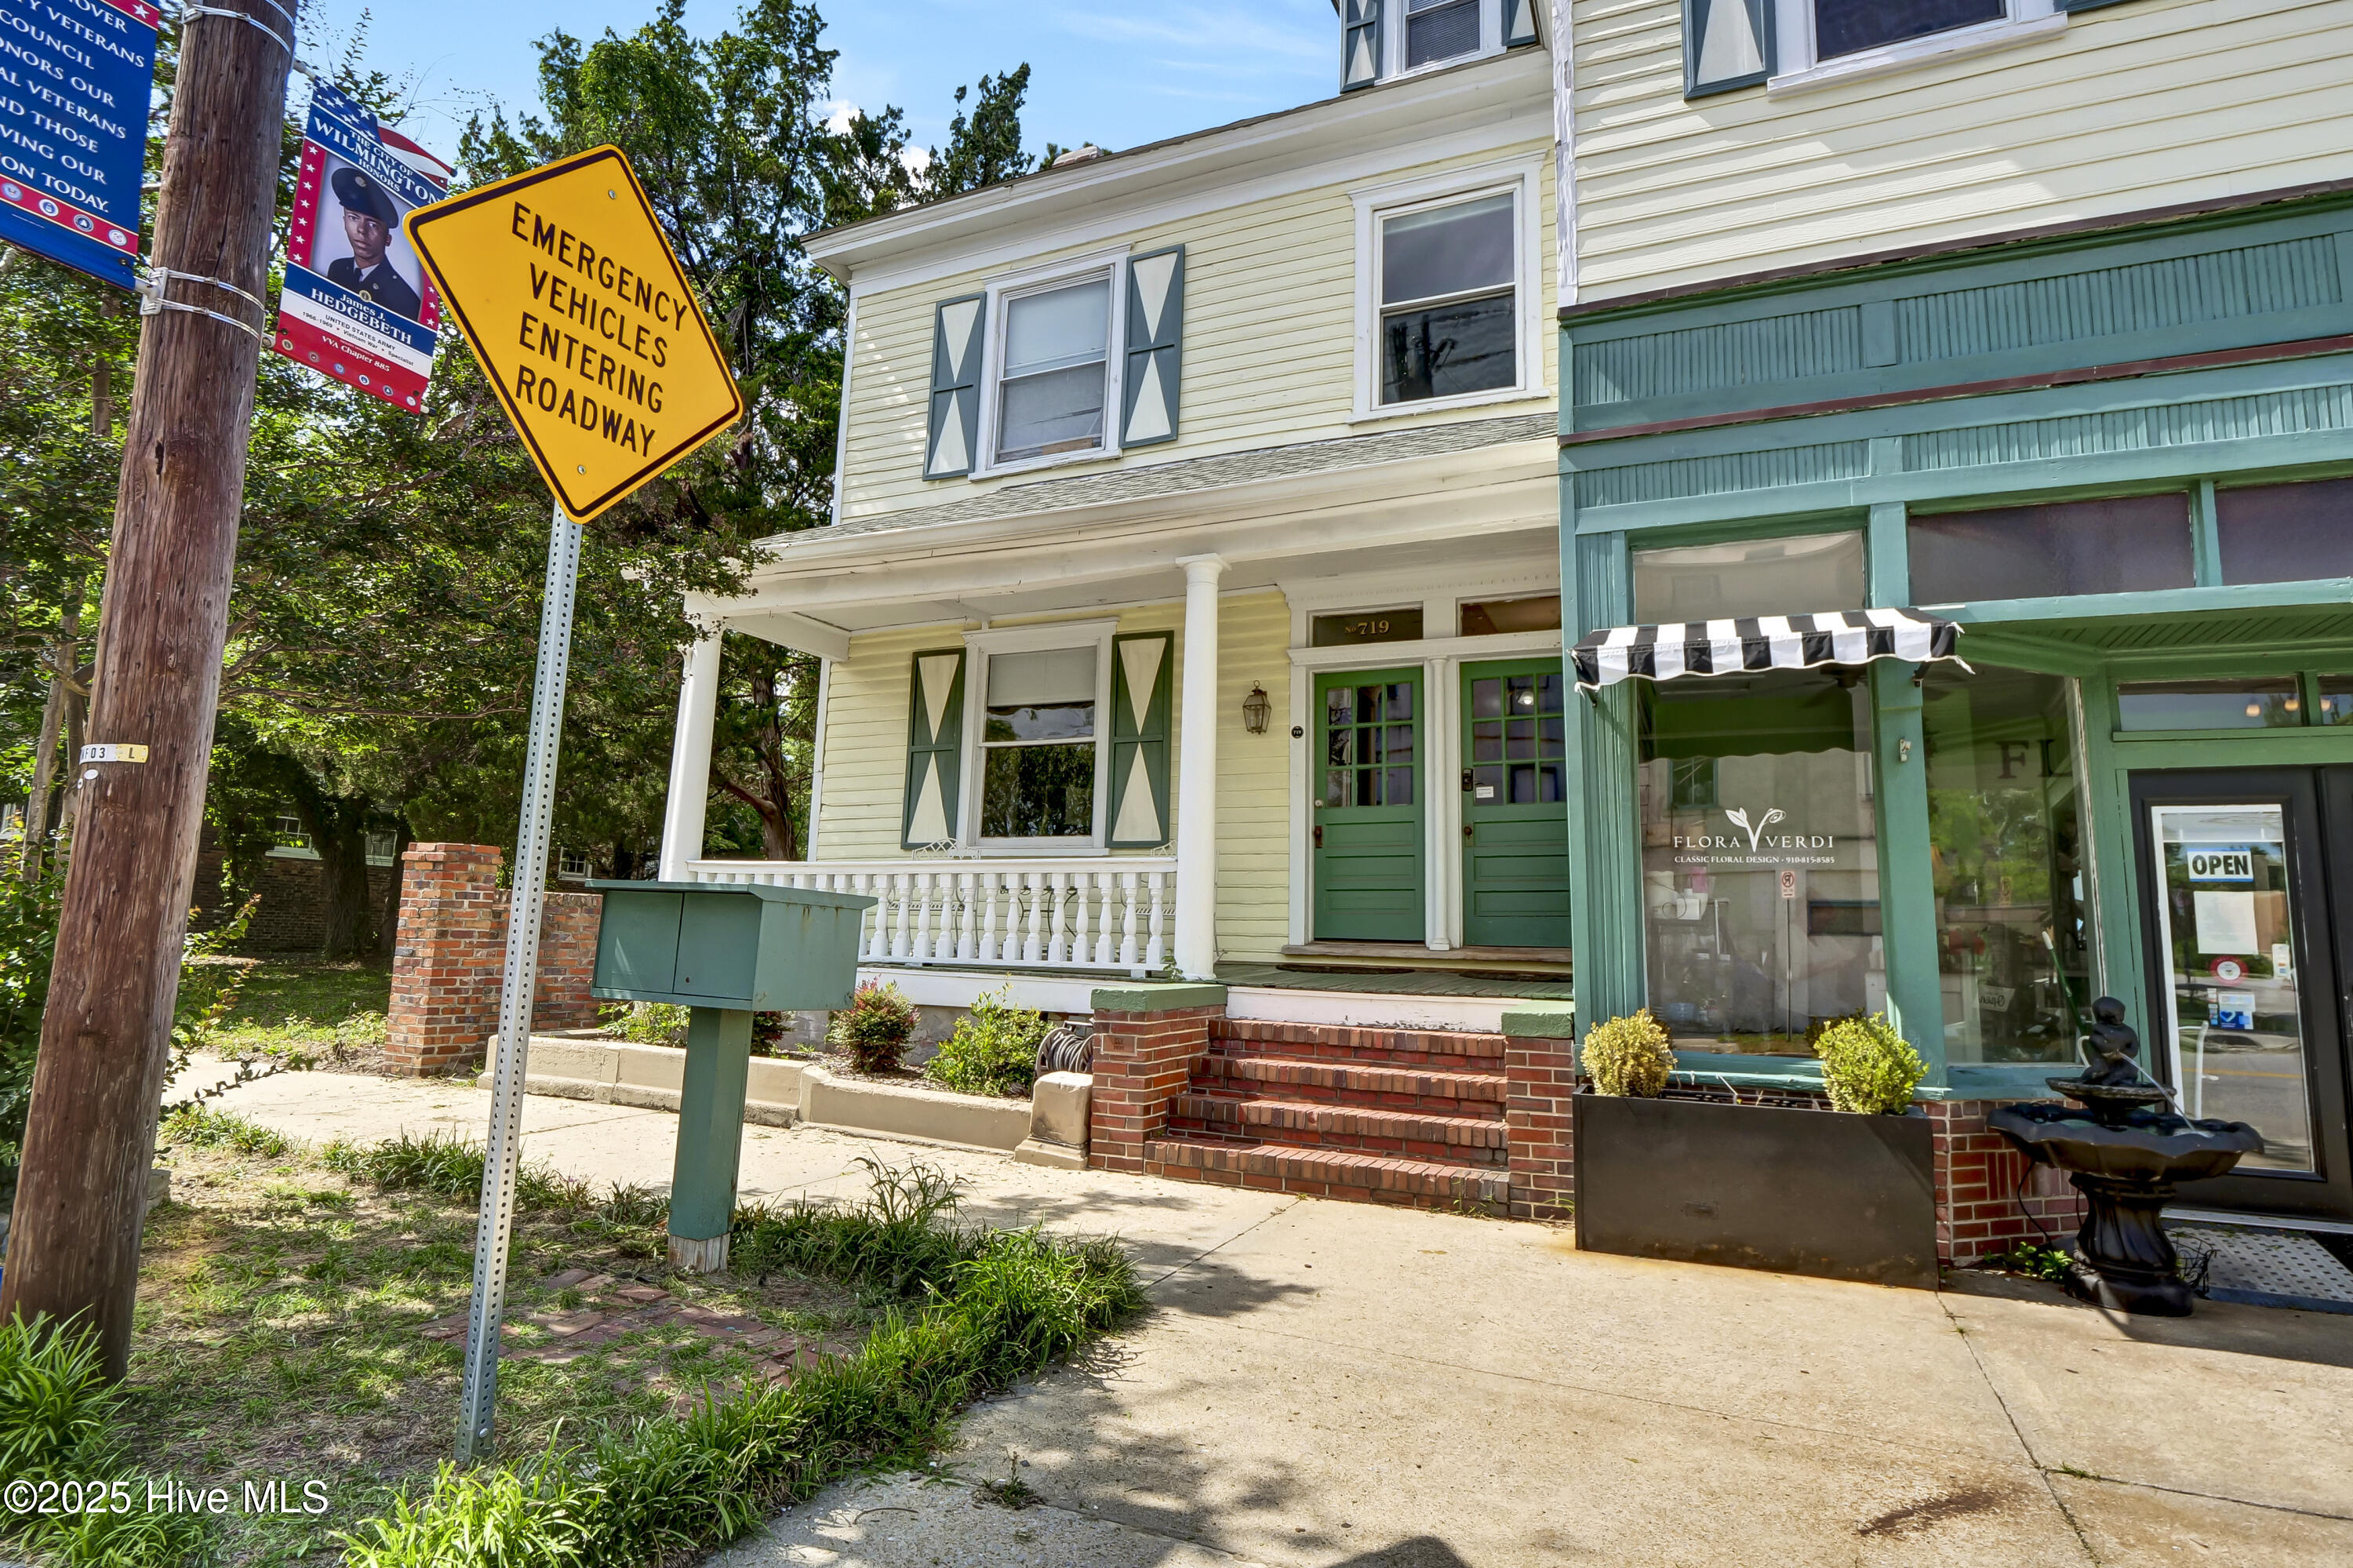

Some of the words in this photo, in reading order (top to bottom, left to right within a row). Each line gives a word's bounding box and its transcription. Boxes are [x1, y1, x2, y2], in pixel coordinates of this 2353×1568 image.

[0, 9, 95, 69] COUNCIL
[46, 6, 145, 67] VETERANS
[26, 79, 126, 139] VETERANS
[71, 77, 116, 108] OUR
[30, 110, 98, 153] THOSE
[61, 155, 107, 185] OUR
[350, 129, 371, 148] THE
[373, 147, 398, 168] CITY
[399, 165, 413, 176] OF
[42, 172, 109, 213] TODAY.
[358, 158, 400, 191] HONORS
[511, 201, 689, 331] EMERGENCY
[311, 288, 412, 345] HEDGEBETH
[340, 294, 376, 316] James
[378, 312, 386, 322] J.
[529, 262, 668, 368] VEHICLES
[325, 315, 351, 329] UNITED
[351, 326, 376, 342] STATES
[378, 339, 395, 351] ARMY
[344, 329, 366, 344] Vietnam
[368, 340, 378, 349] War
[388, 351, 413, 366] Specialist
[322, 335, 339, 349] VVA
[340, 345, 373, 363] Chapter
[374, 360, 390, 372] 885
[519, 311, 664, 413] ENTERING
[515, 364, 656, 458] ROADWAY
[1358, 620, 1390, 635] 719
[129, 748, 135, 759] L
[1674, 835, 1740, 848] FLORA
[1766, 835, 1834, 848] VERDI
[2192, 855, 2249, 875] OPEN
